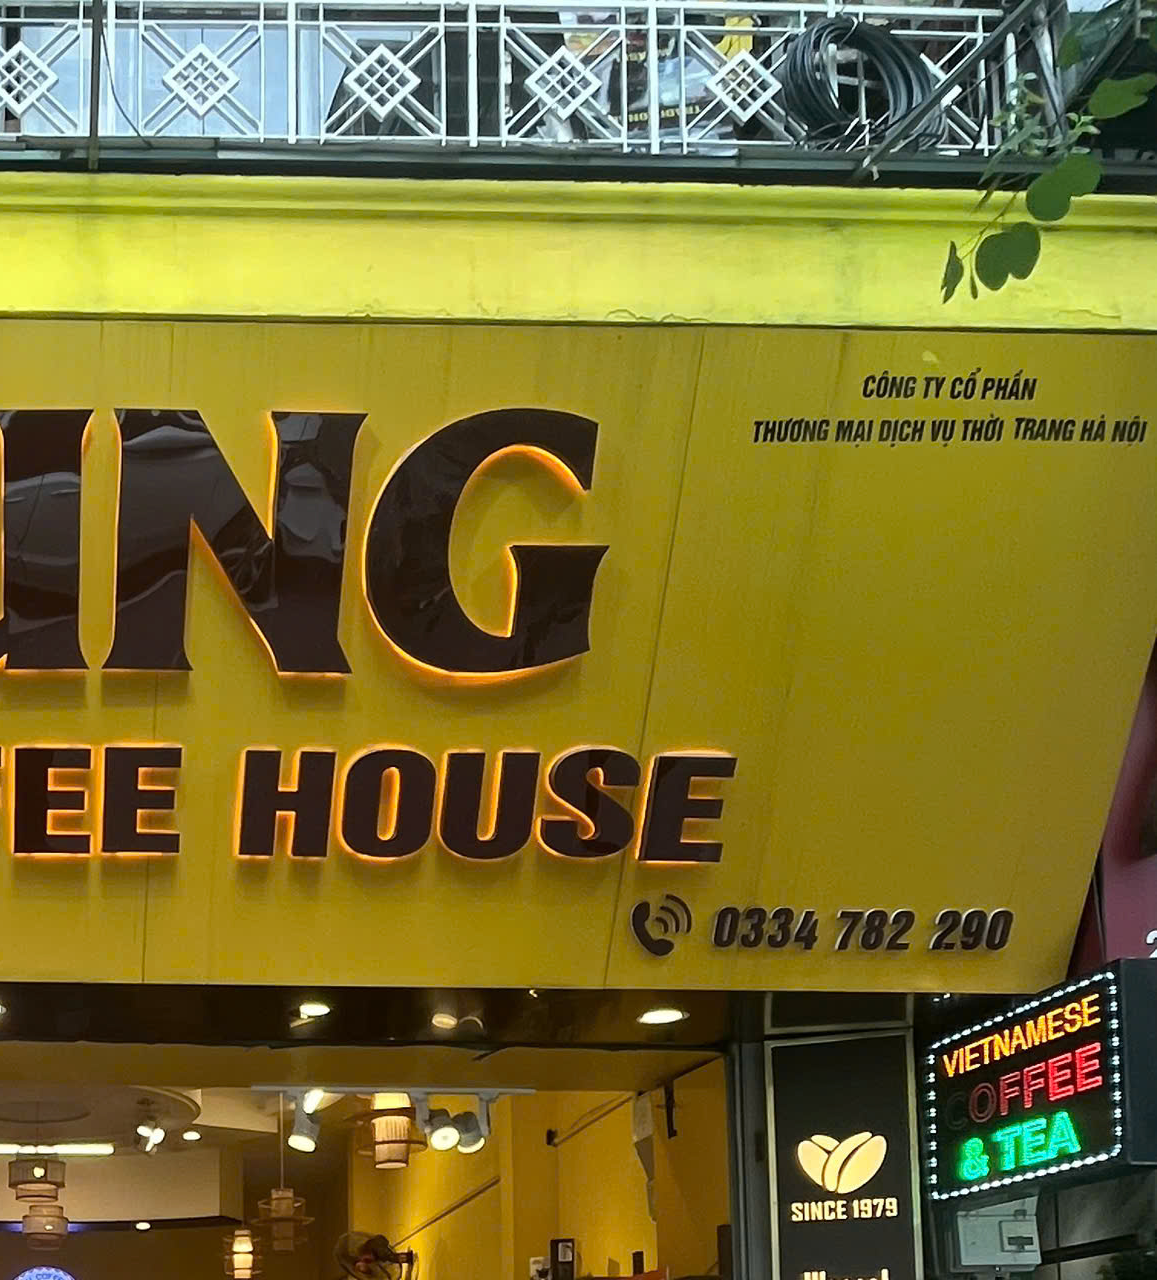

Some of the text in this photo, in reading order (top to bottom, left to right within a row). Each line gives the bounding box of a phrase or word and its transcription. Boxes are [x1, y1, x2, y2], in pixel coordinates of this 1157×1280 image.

[863, 370, 917, 398] CÔNG
[923, 376, 946, 399] TY
[950, 367, 981, 399] CỔ
[754, 417, 830, 443] THƯƠNG
[835, 419, 874, 448] MẠI
[878, 420, 927, 448] DỊCH
[930, 420, 956, 449] VỤ
[961, 412, 1005, 442] THỜI
[1014, 417, 1076, 442] TRANG
[1111, 415, 1148, 447] NỘI
[237, 747, 737, 863] HOUSE
[712, 906, 1014, 952] 0334 782 290
[943, 993, 1102, 1078] VIETNAMESE
[945, 1042, 1104, 1130] COFFEE
[959, 1111, 1082, 1181] & TEA
[791, 1197, 898, 1222] SINCE 1979
